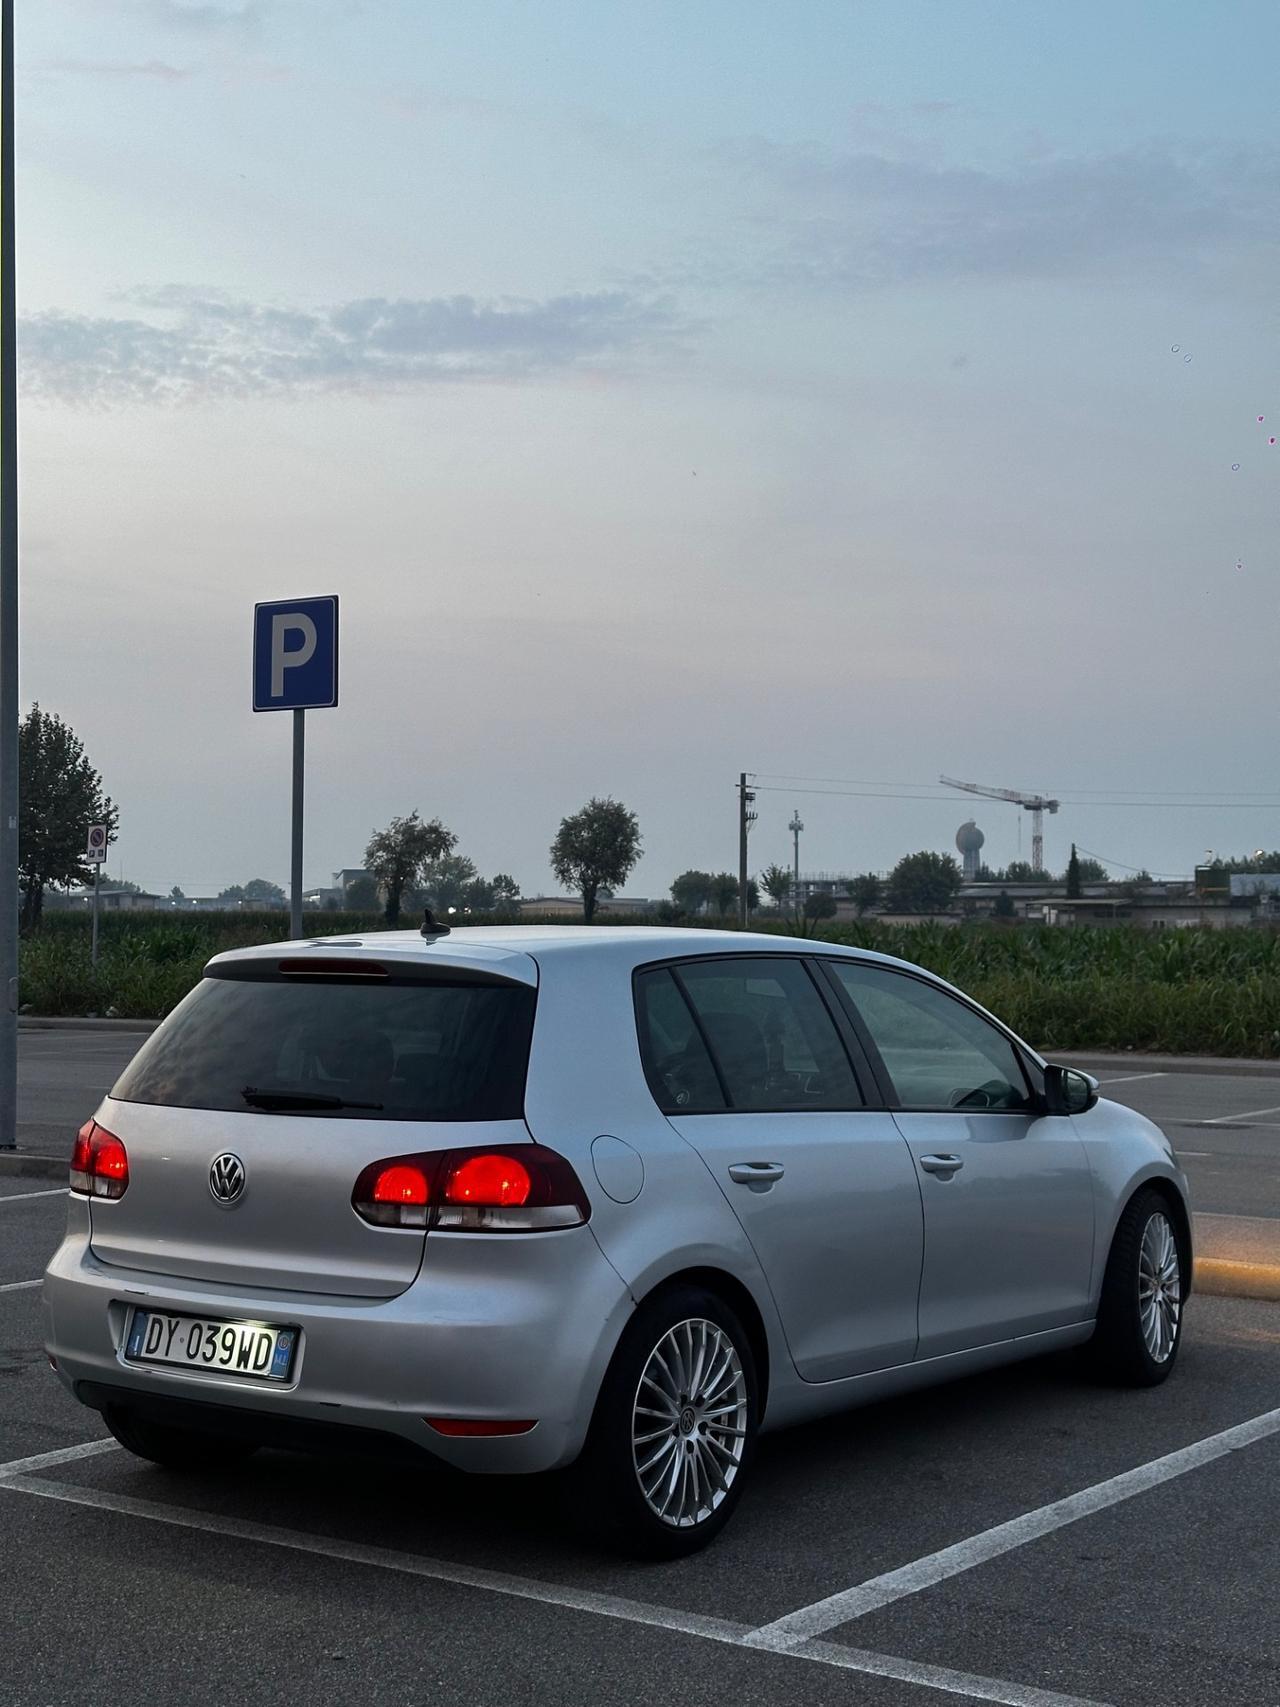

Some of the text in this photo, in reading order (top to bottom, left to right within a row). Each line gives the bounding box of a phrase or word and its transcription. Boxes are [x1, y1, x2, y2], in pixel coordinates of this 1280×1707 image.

[271, 613, 317, 697] P
[146, 1318, 273, 1370] DY 039WD
